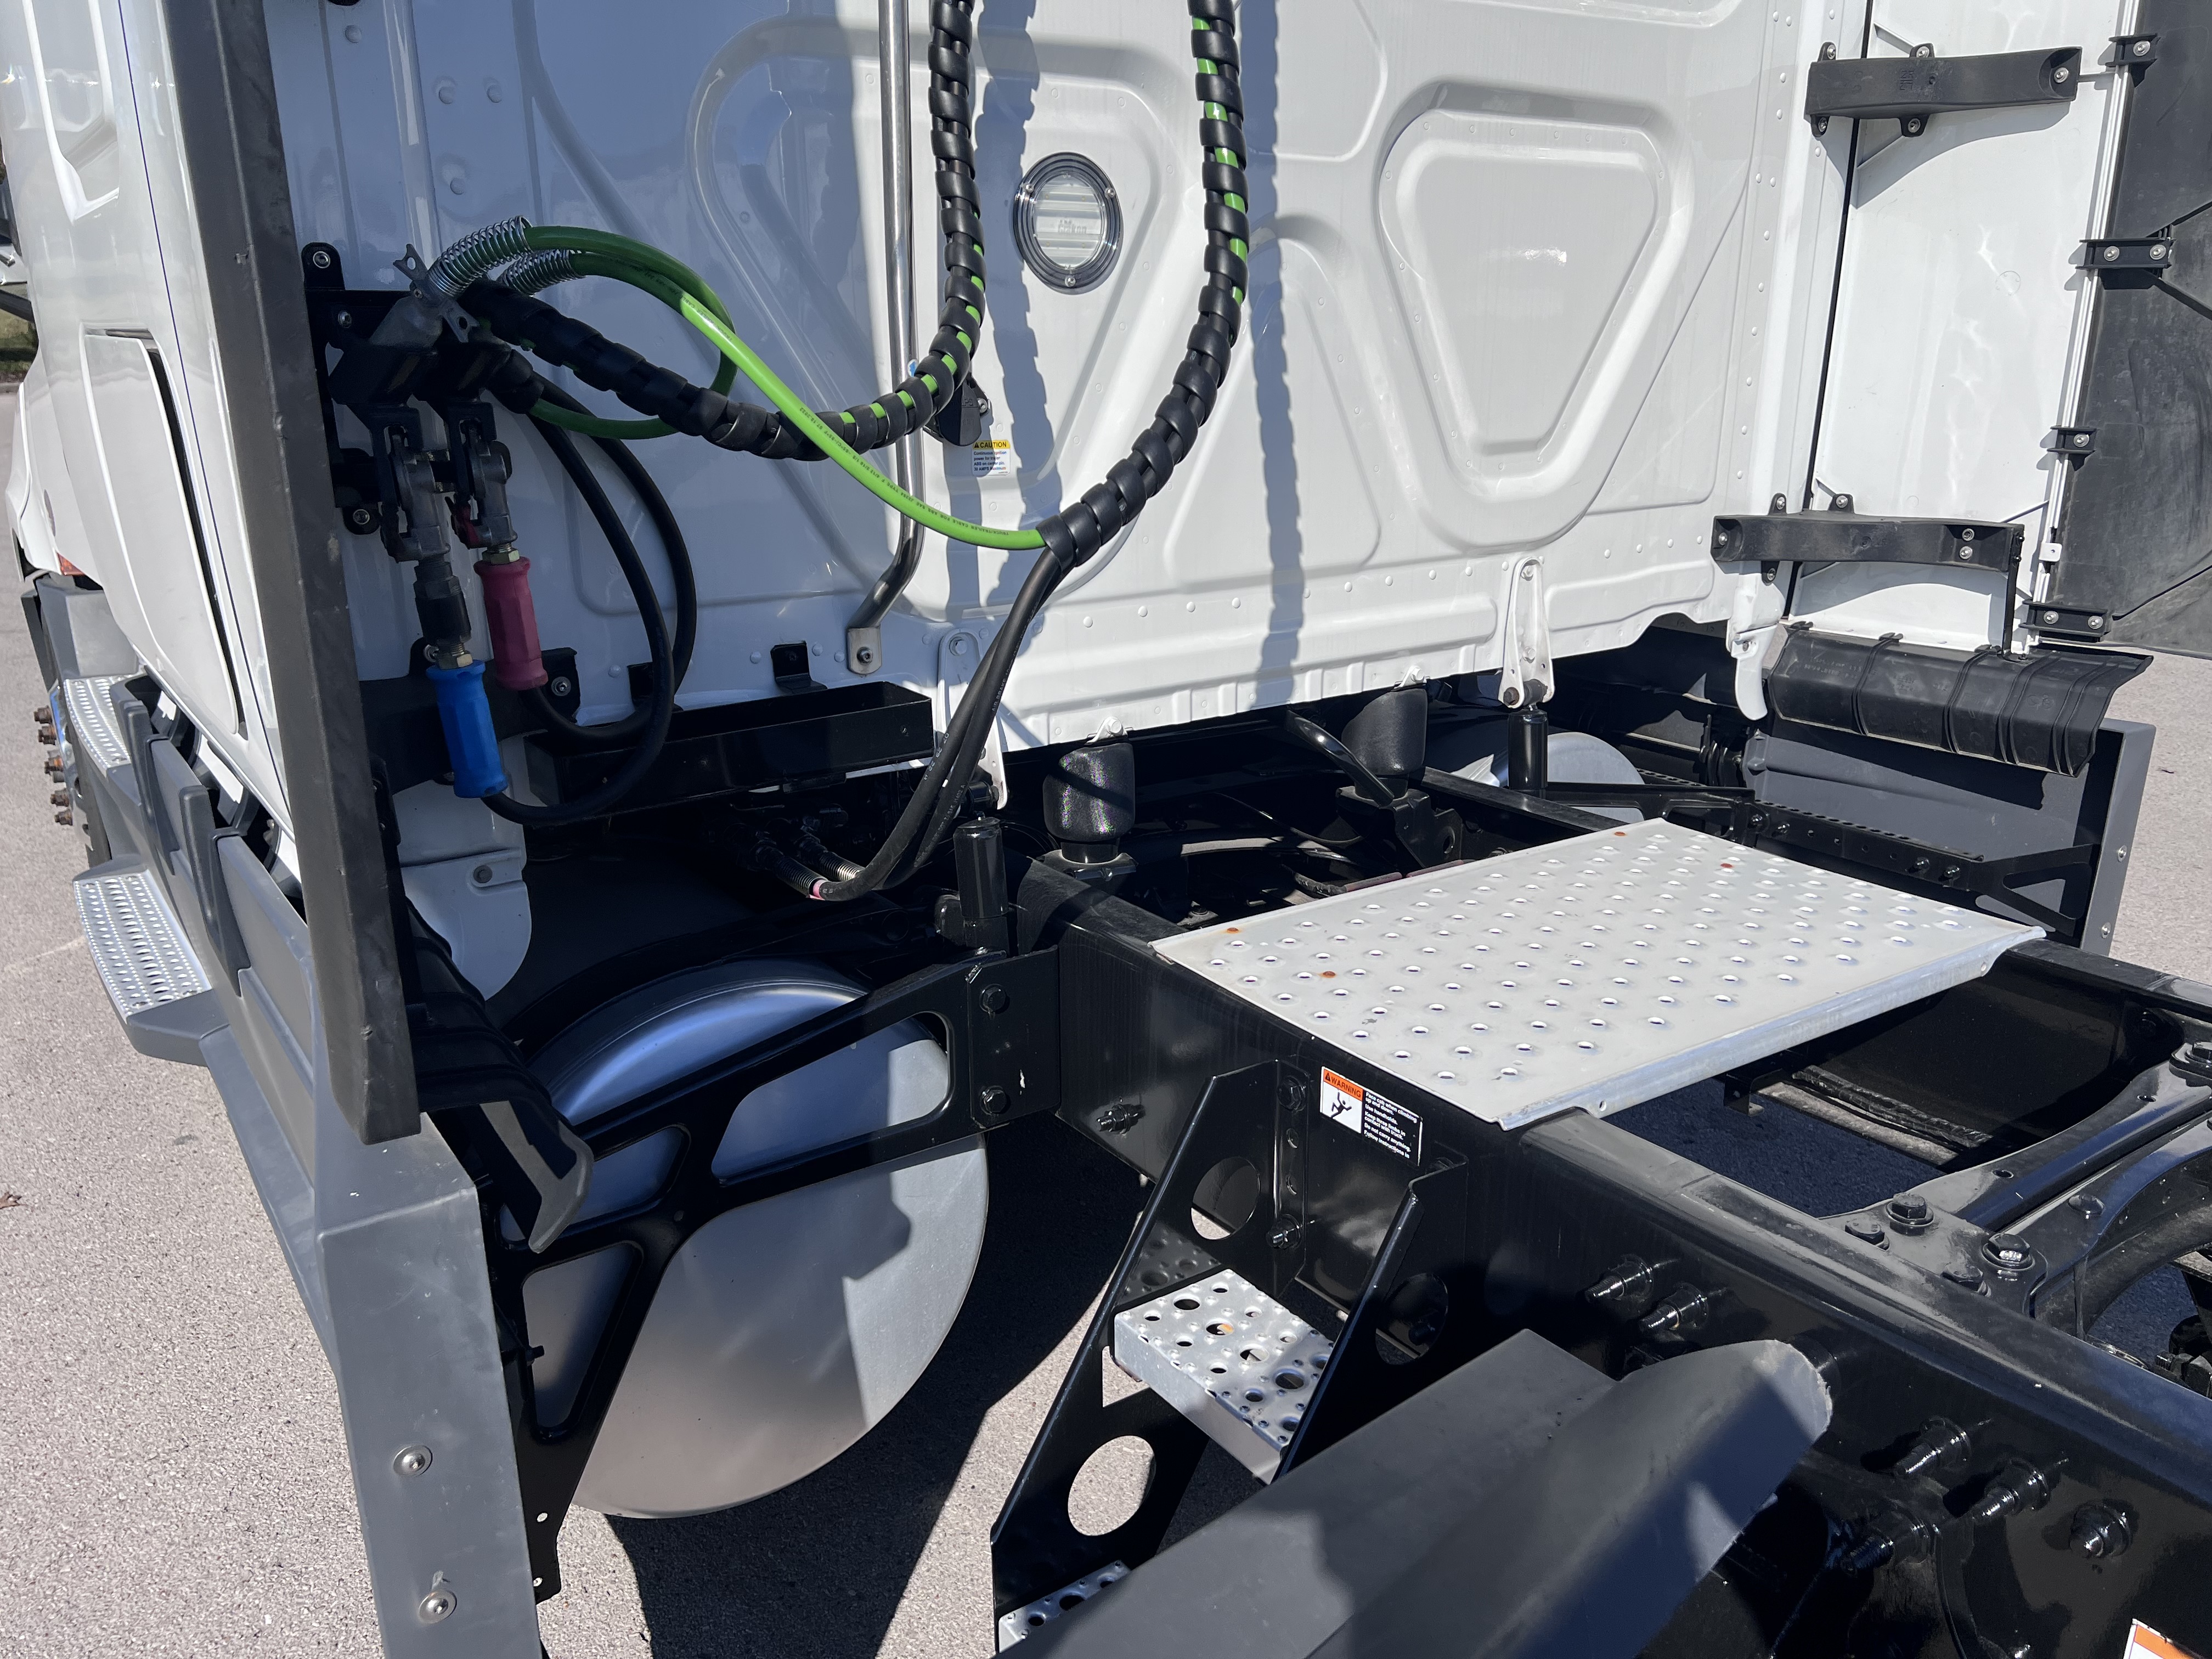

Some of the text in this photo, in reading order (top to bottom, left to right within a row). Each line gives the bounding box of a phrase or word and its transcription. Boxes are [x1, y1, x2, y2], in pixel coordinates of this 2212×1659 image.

[887, 483, 898, 493] TYPE
[952, 518, 969, 528] CABLE
[1331, 1076, 1362, 1098] WARNING
[1365, 1092, 1417, 1124] Face cab when climbing
[1372, 1099, 1380, 1108] and
[1381, 1104, 1394, 1115] down.
[1364, 1111, 1376, 1122] Keep
[1376, 1116, 1388, 1127] three
[1388, 1122, 1401, 1133] limbs
[1364, 1116, 1404, 1140] contact with truck.
[1364, 1129, 1379, 1142] Follow
[1379, 1137, 1404, 1156] instructions
[1379, 1131, 1390, 1141] carry
[1390, 1137, 1411, 1153] anything.
